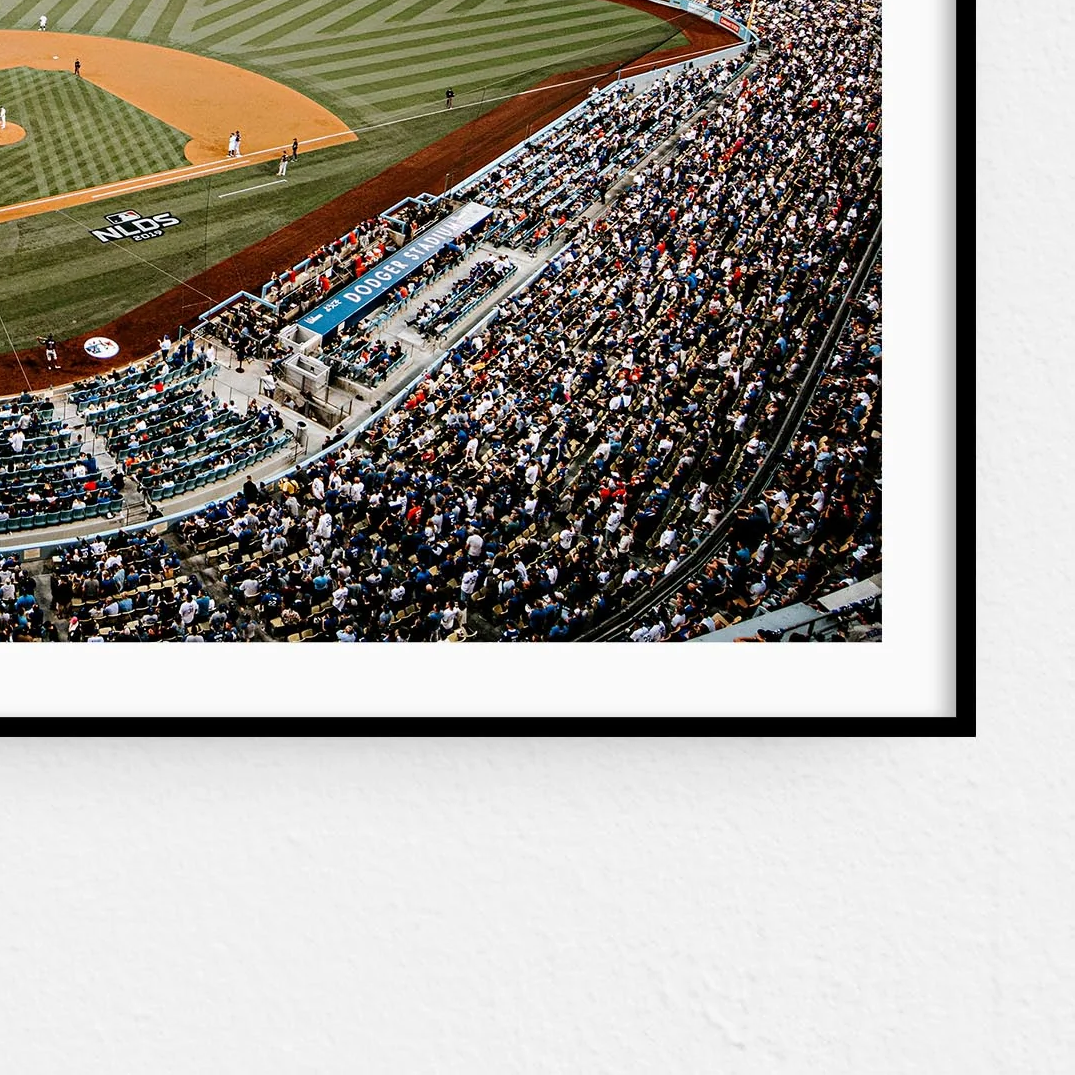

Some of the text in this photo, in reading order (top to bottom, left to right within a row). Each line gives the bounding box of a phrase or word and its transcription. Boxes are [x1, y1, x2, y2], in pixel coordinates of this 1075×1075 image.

[92, 213, 179, 242] NLDS
[132, 230, 163, 241] 2019
[343, 260, 409, 303] DODGER
[268, 599, 277, 607] 22
